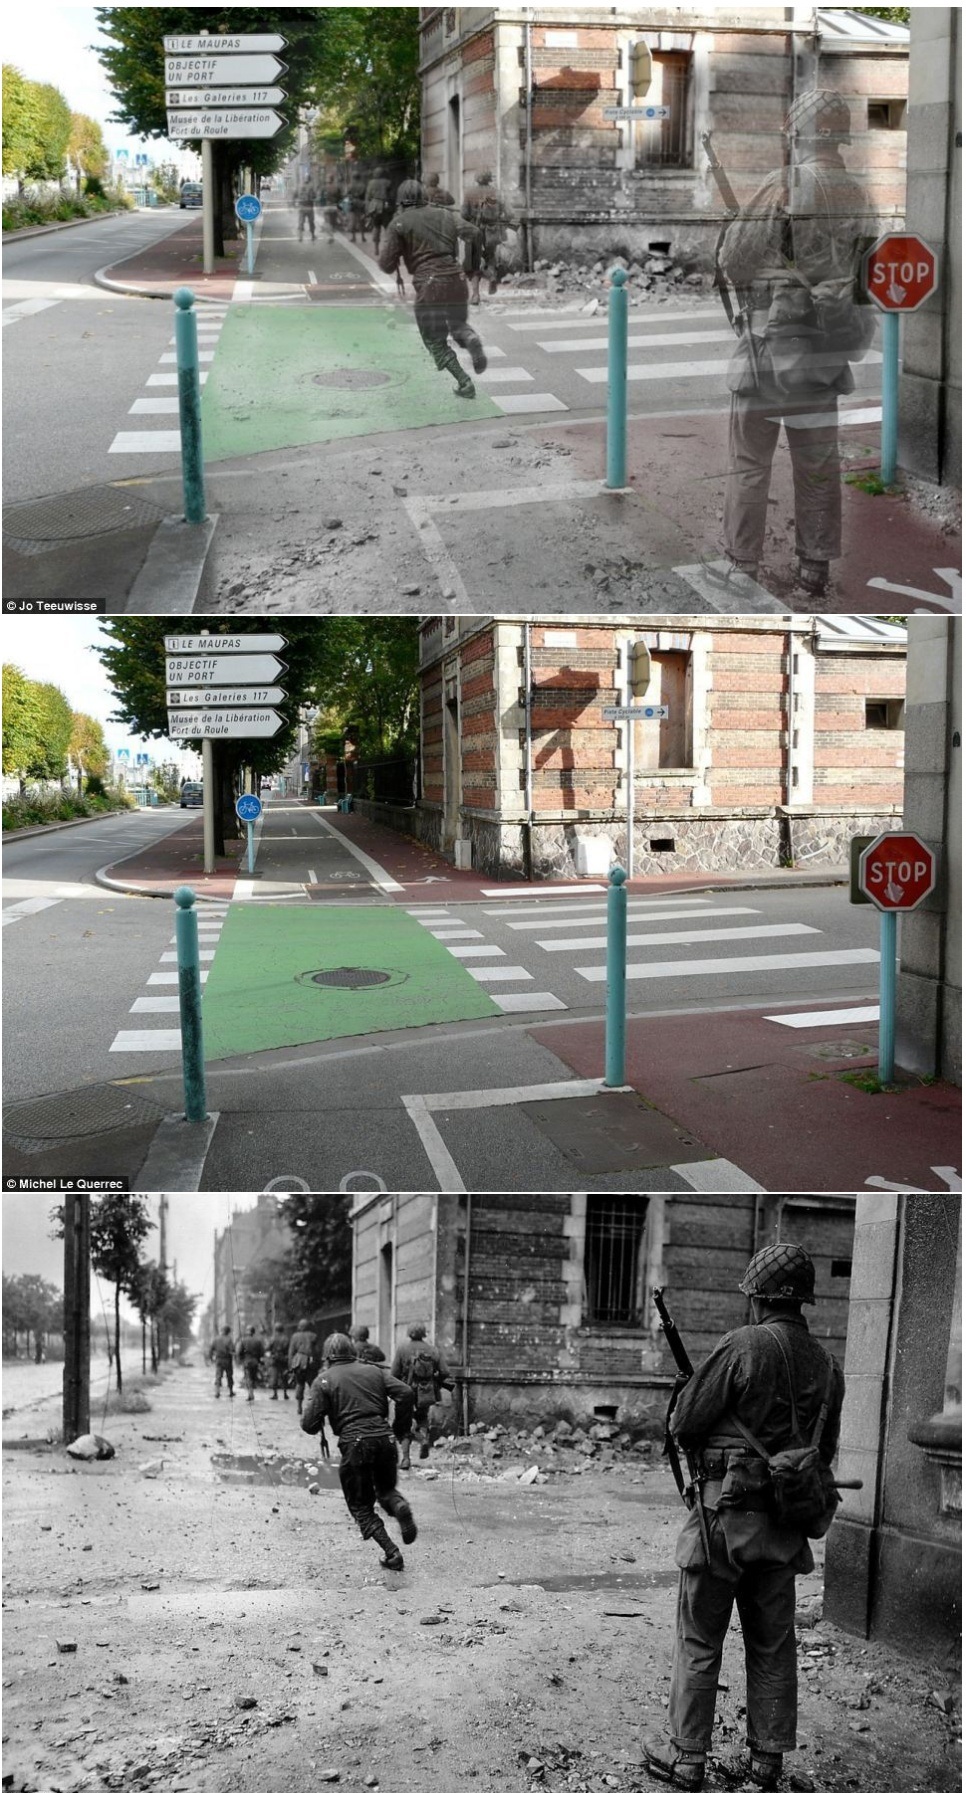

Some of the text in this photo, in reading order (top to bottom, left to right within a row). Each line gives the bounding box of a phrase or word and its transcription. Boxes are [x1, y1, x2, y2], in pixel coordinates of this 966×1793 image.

[181, 39, 240, 48] LE MAUPAS
[168, 60, 217, 70] OBJECTIF
[168, 71, 214, 81] UN PORT
[183, 91, 268, 102] Les Galeries 117
[170, 115, 198, 124] Musée
[214, 114, 223, 122] la
[225, 113, 270, 122] Libération
[170, 126, 228, 134] Fort du Roule
[873, 262, 929, 284] STOP
[182, 639, 240, 648] LE MAUPAS
[169, 660, 217, 670] OBJECTIF
[169, 671, 214, 681] UN PORT
[184, 691, 268, 702] Les Galeries 117
[170, 713, 270, 723] Musée de la Libération
[171, 725, 229, 734] Fort du Roule
[870, 861, 927, 883] STOP
